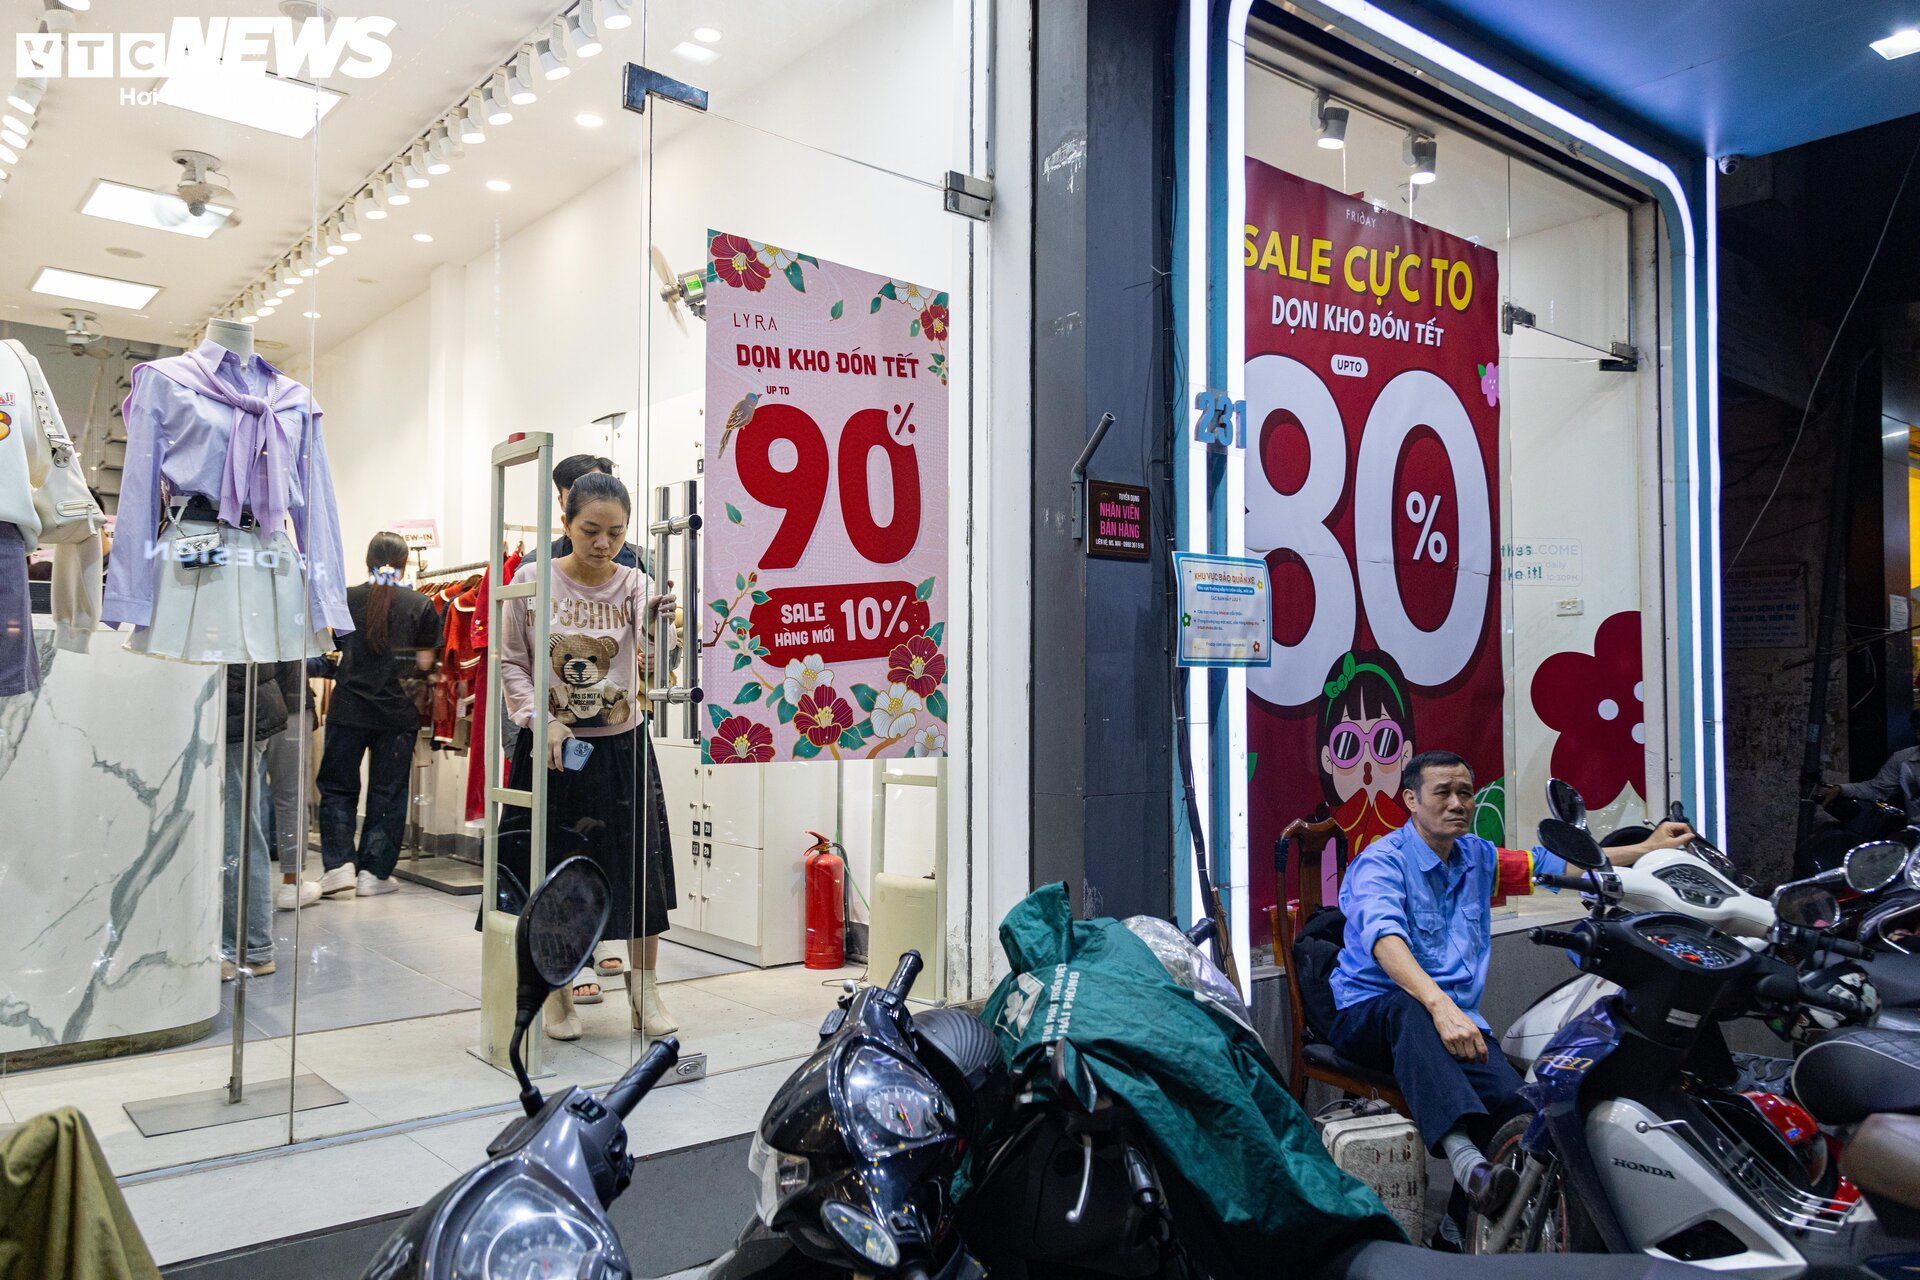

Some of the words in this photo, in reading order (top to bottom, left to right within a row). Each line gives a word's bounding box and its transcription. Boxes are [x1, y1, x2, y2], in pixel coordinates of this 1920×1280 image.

[1346, 208, 1376, 228] FRIDAY
[1244, 224, 1332, 285] SALE
[1343, 244, 1421, 306] CỰC
[1431, 258, 1473, 311] TO
[733, 312, 778, 331] LYRA
[1272, 294, 1318, 335] DỌN
[1323, 303, 1364, 335] KHO
[1369, 310, 1410, 342] ĐÓN
[1415, 317, 1444, 347] TẾT
[736, 343, 781, 373] DỌN
[788, 347, 830, 373] KHO
[835, 346, 877, 376] ĐÓN
[882, 352, 919, 379] TẾT
[1336, 359, 1362, 373] UPTO
[766, 385, 777, 395] UP
[779, 386, 790, 396] TO
[1194, 391, 1247, 449] 231
[1100, 501, 1121, 518] NHÂN
[1123, 503, 1140, 520] VIÊN
[402, 533, 433, 542] EW-IN
[1100, 518, 1116, 537] BÁN
[1119, 520, 1140, 538] HÀNG
[1194, 572, 1206, 581] KHU
[1218, 570, 1231, 583] BẢO
[1248, 576, 1255, 584] XE
[780, 602, 826, 625] SALE
[840, 595, 909, 641] 10%
[775, 627, 809, 647] HÀNG
[812, 624, 835, 644] MỚI
[1062, 971, 1080, 1009] PHÒNG
[1057, 1012, 1071, 1034] HẢI
[1611, 1157, 1676, 1180] HONDA
